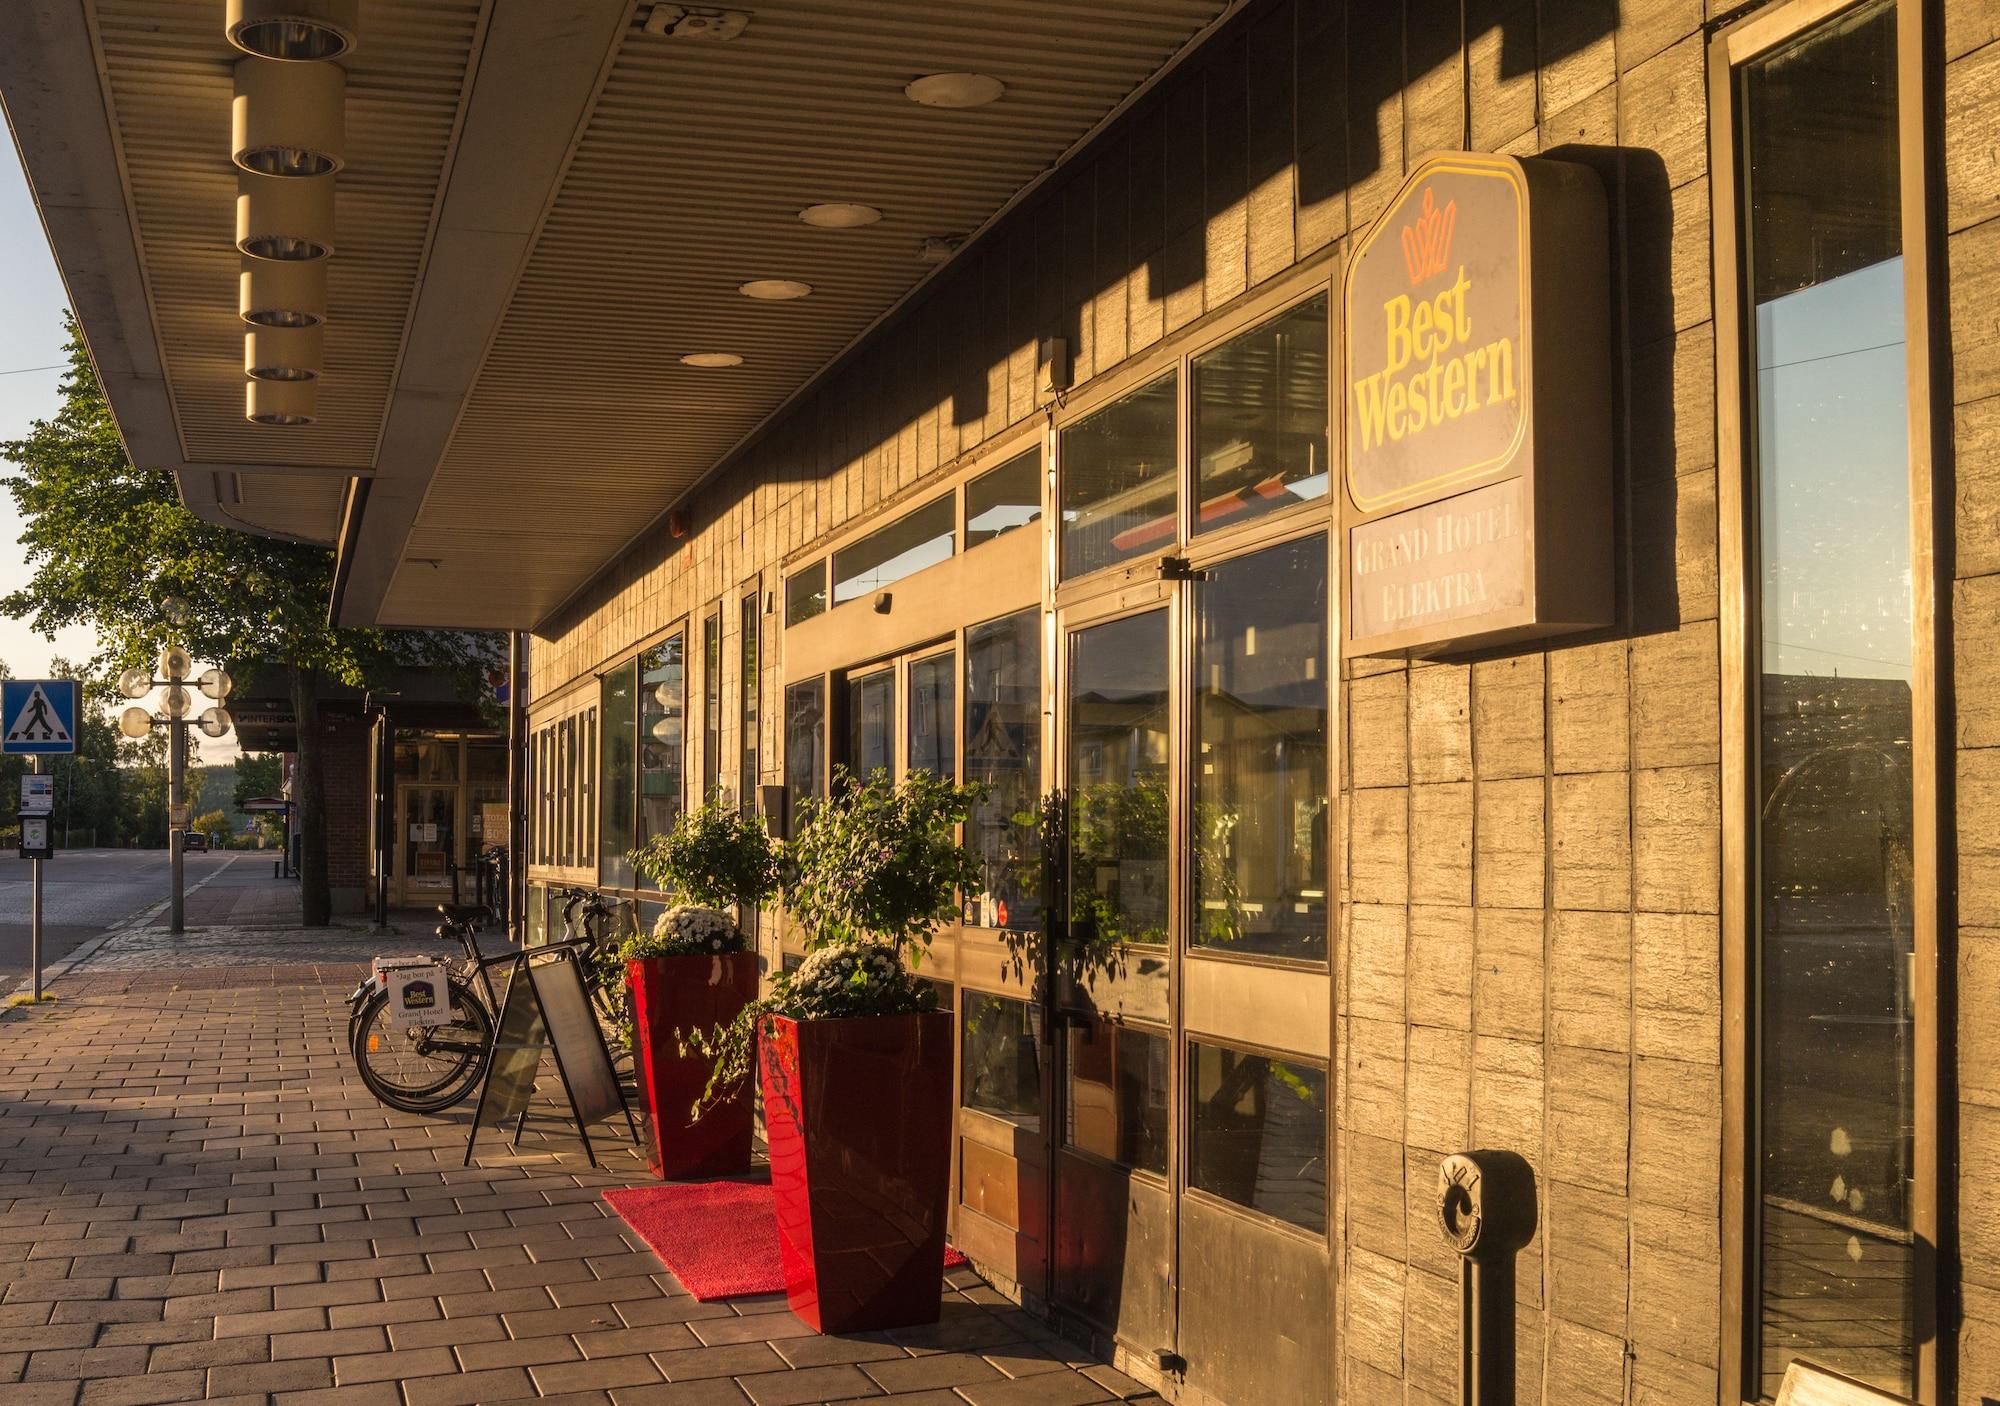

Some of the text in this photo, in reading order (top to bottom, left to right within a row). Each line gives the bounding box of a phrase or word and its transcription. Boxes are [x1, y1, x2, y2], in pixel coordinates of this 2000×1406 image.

[1384, 265, 1471, 373] Best
[1354, 332, 1516, 451] Western
[1355, 503, 1518, 575] GRAND HOTEL
[1381, 568, 1487, 622] ELEKTRA
[399, 972, 411, 980] Jag
[426, 970, 434, 979] på
[404, 997, 434, 1005] Western
[410, 990, 426, 998] Best
[398, 1008, 443, 1018] Grand Hotel
